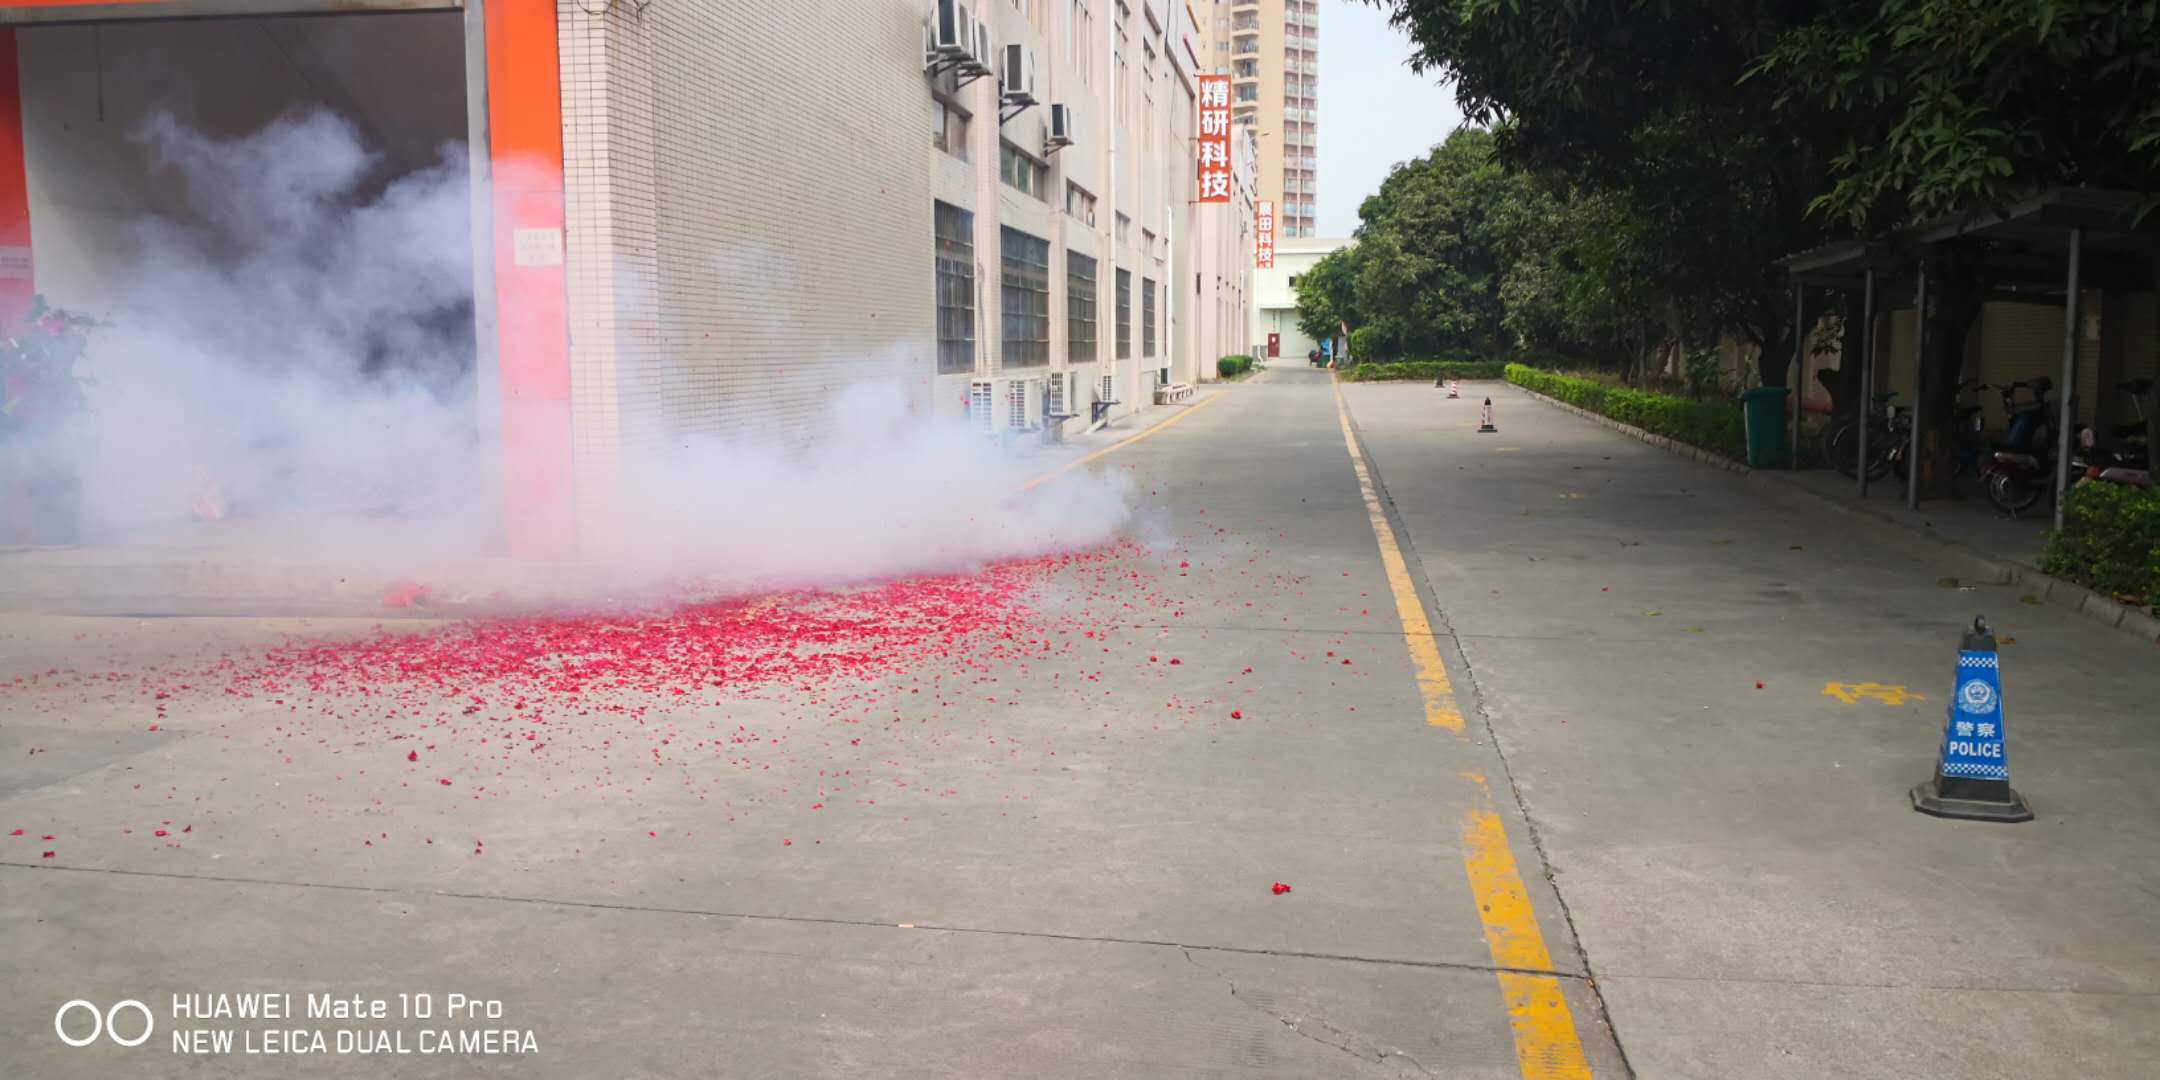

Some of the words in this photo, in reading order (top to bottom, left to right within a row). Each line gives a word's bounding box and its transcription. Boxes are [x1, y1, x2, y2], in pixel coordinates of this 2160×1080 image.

[1201, 80, 1229, 198] 精研科技
[1956, 721, 1995, 737] 警察
[1949, 741, 2001, 758] POLICE
